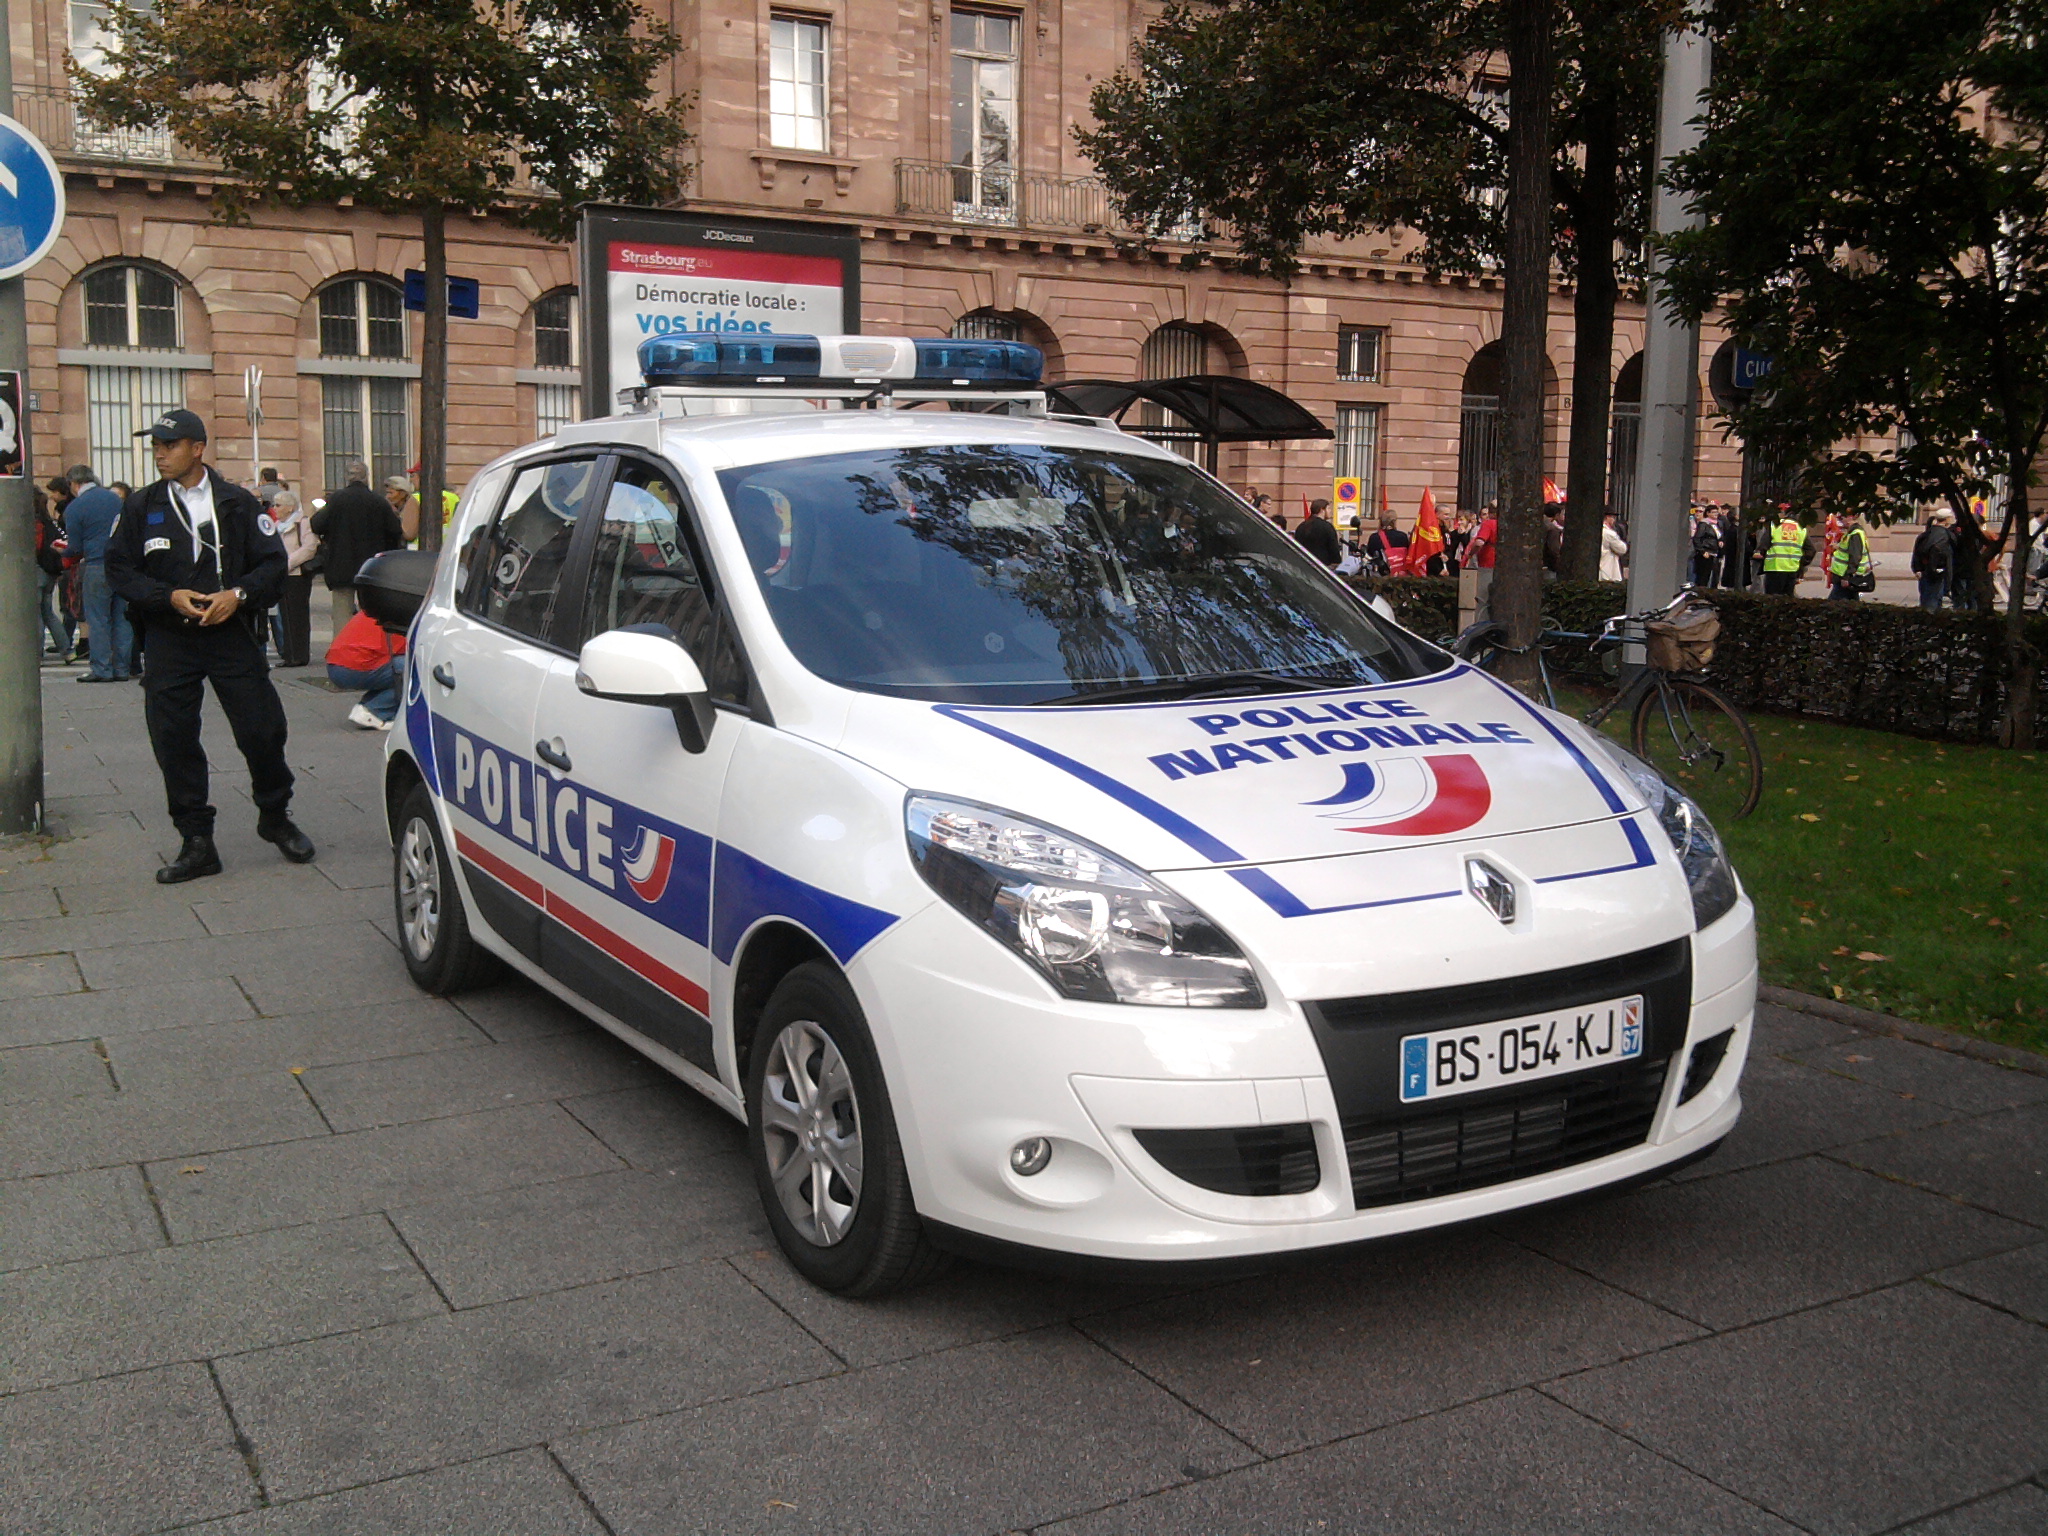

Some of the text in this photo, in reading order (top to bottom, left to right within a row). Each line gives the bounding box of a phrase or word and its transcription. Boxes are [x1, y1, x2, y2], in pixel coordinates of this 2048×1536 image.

[702, 229, 755, 243] JCDecaux
[636, 283, 740, 306] Démocratie
[635, 310, 773, 335] vos idées
[1188, 699, 1430, 736] POLICE
[1147, 721, 1534, 780] NATIONALE
[455, 732, 616, 890] POLICE
[1410, 1009, 1614, 1089] F BS-054-KJ
[1622, 1028, 1639, 1051] 67
